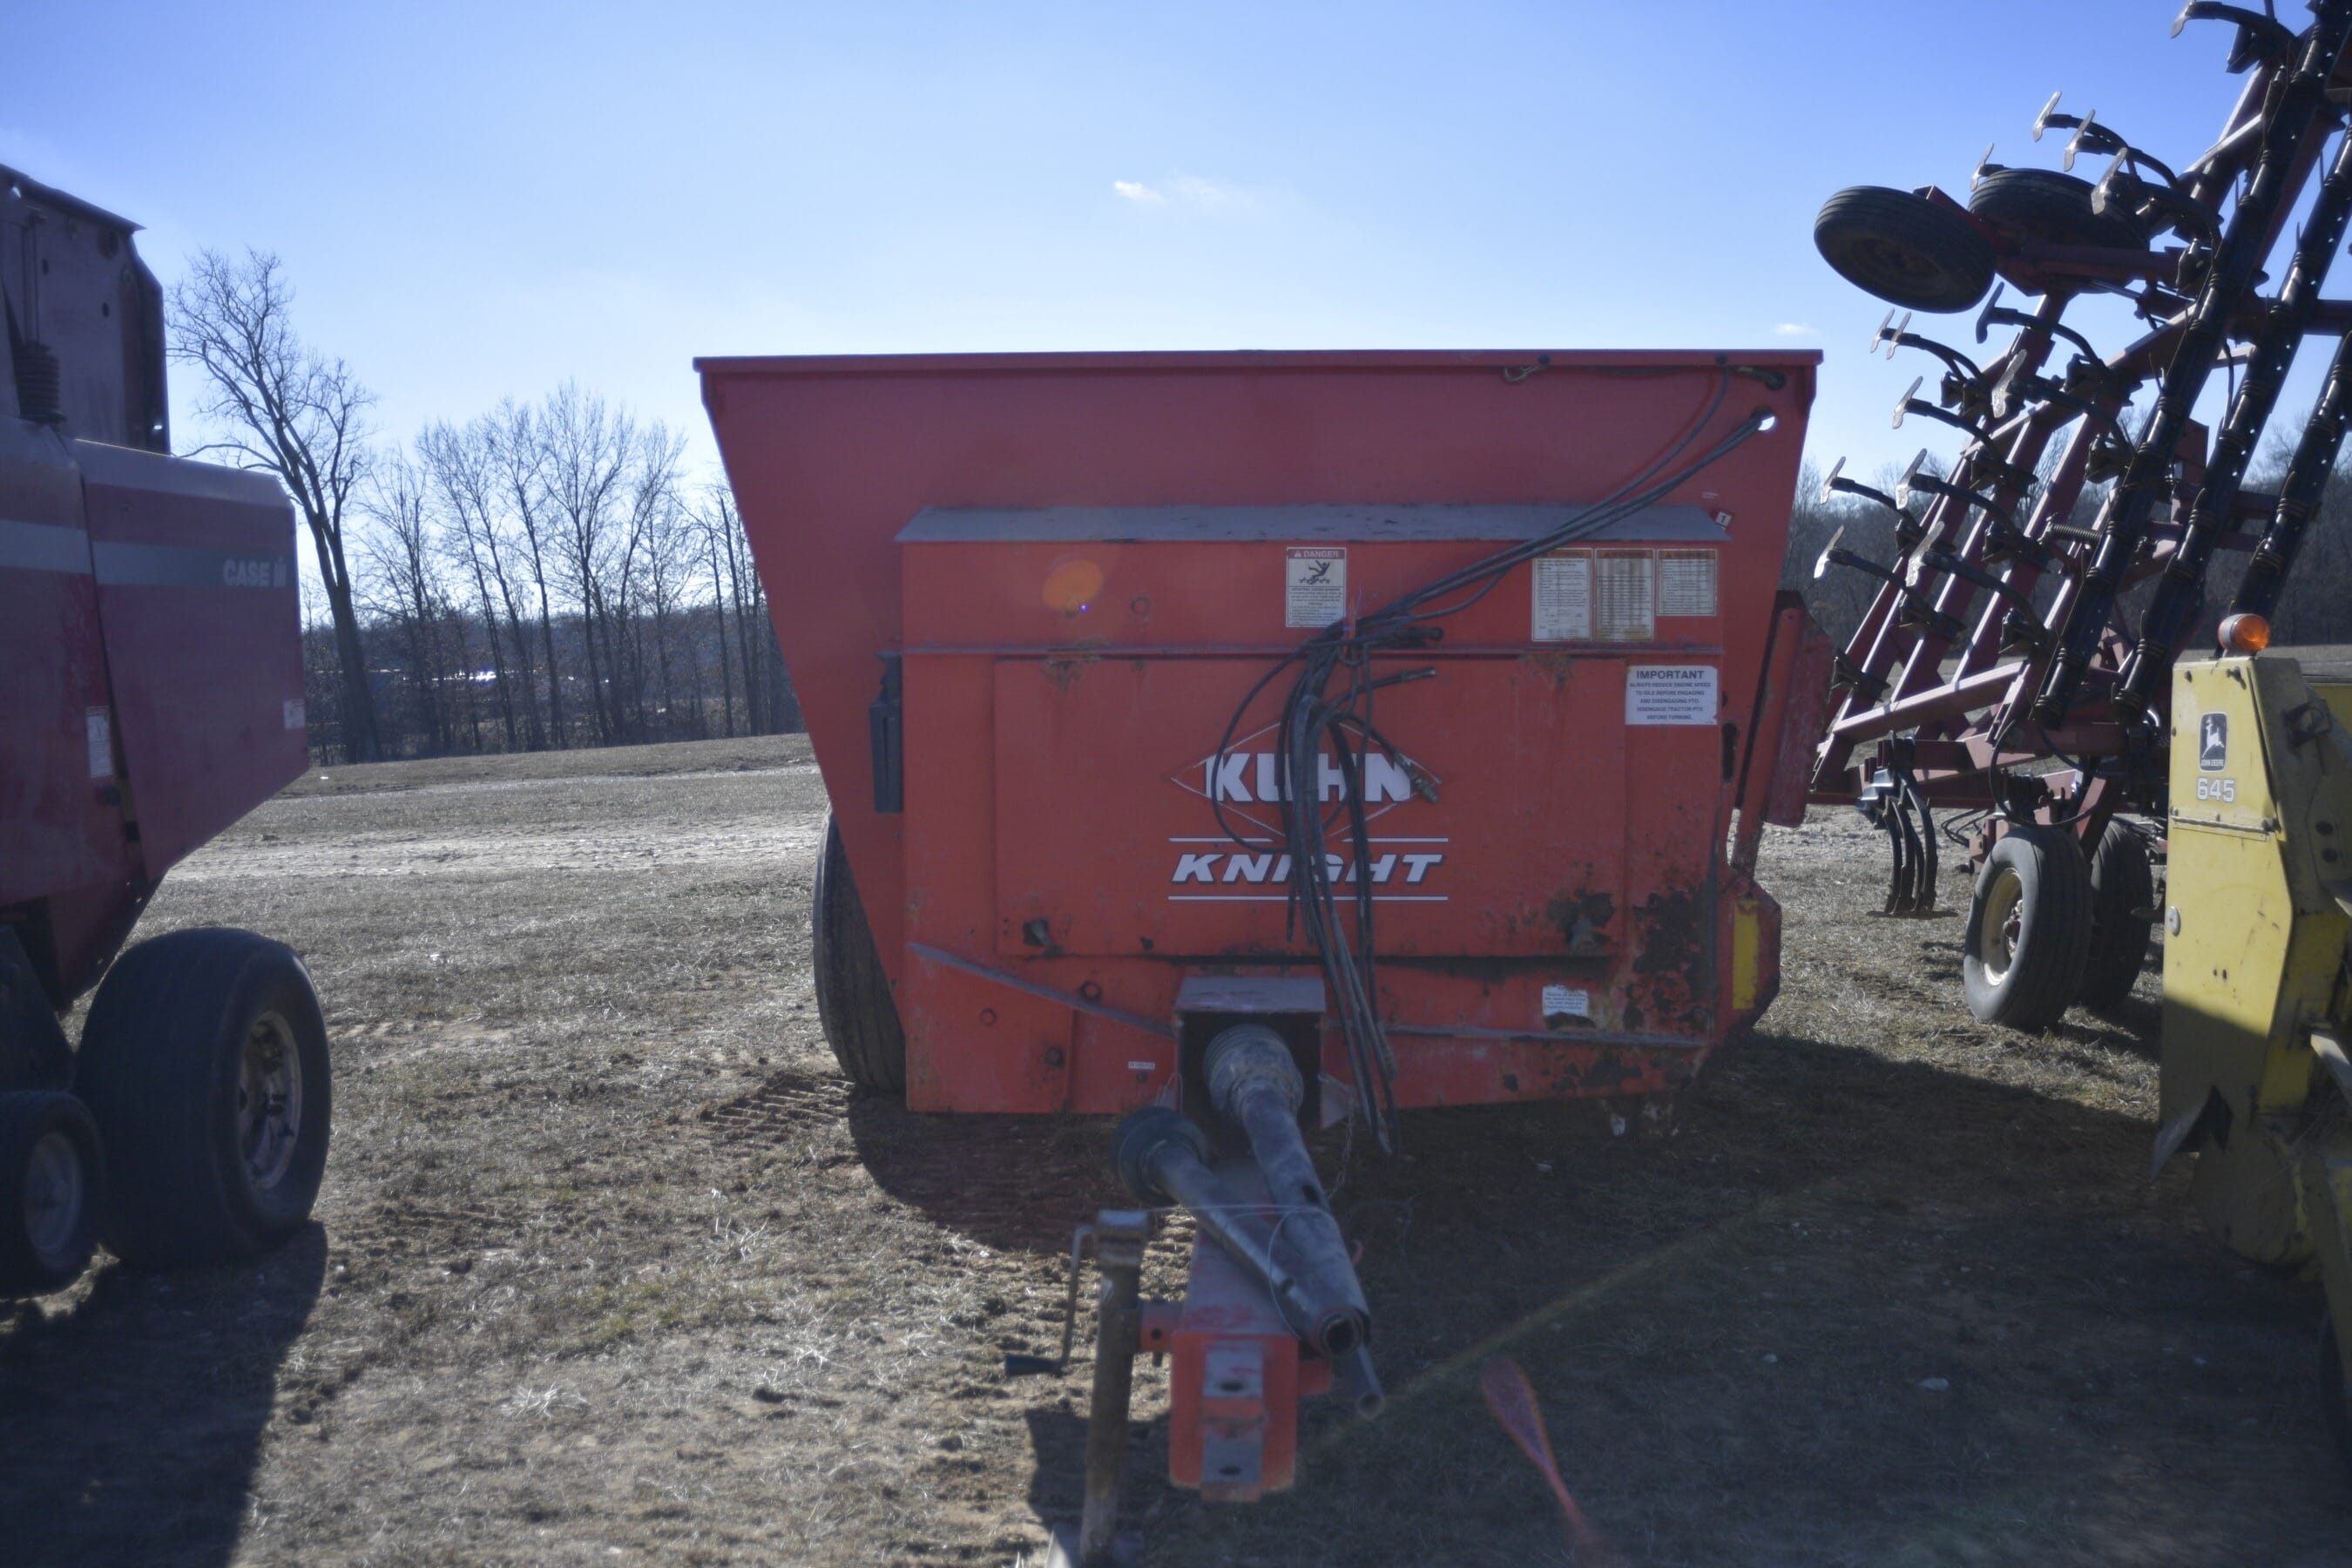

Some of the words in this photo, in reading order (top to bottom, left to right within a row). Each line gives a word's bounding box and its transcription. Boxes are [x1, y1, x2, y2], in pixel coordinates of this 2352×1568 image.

[1303, 550, 1339, 558] DANGER
[224, 559, 269, 586] CASE
[1637, 670, 1704, 679] IMPORTANT
[2197, 778, 2234, 802] 645
